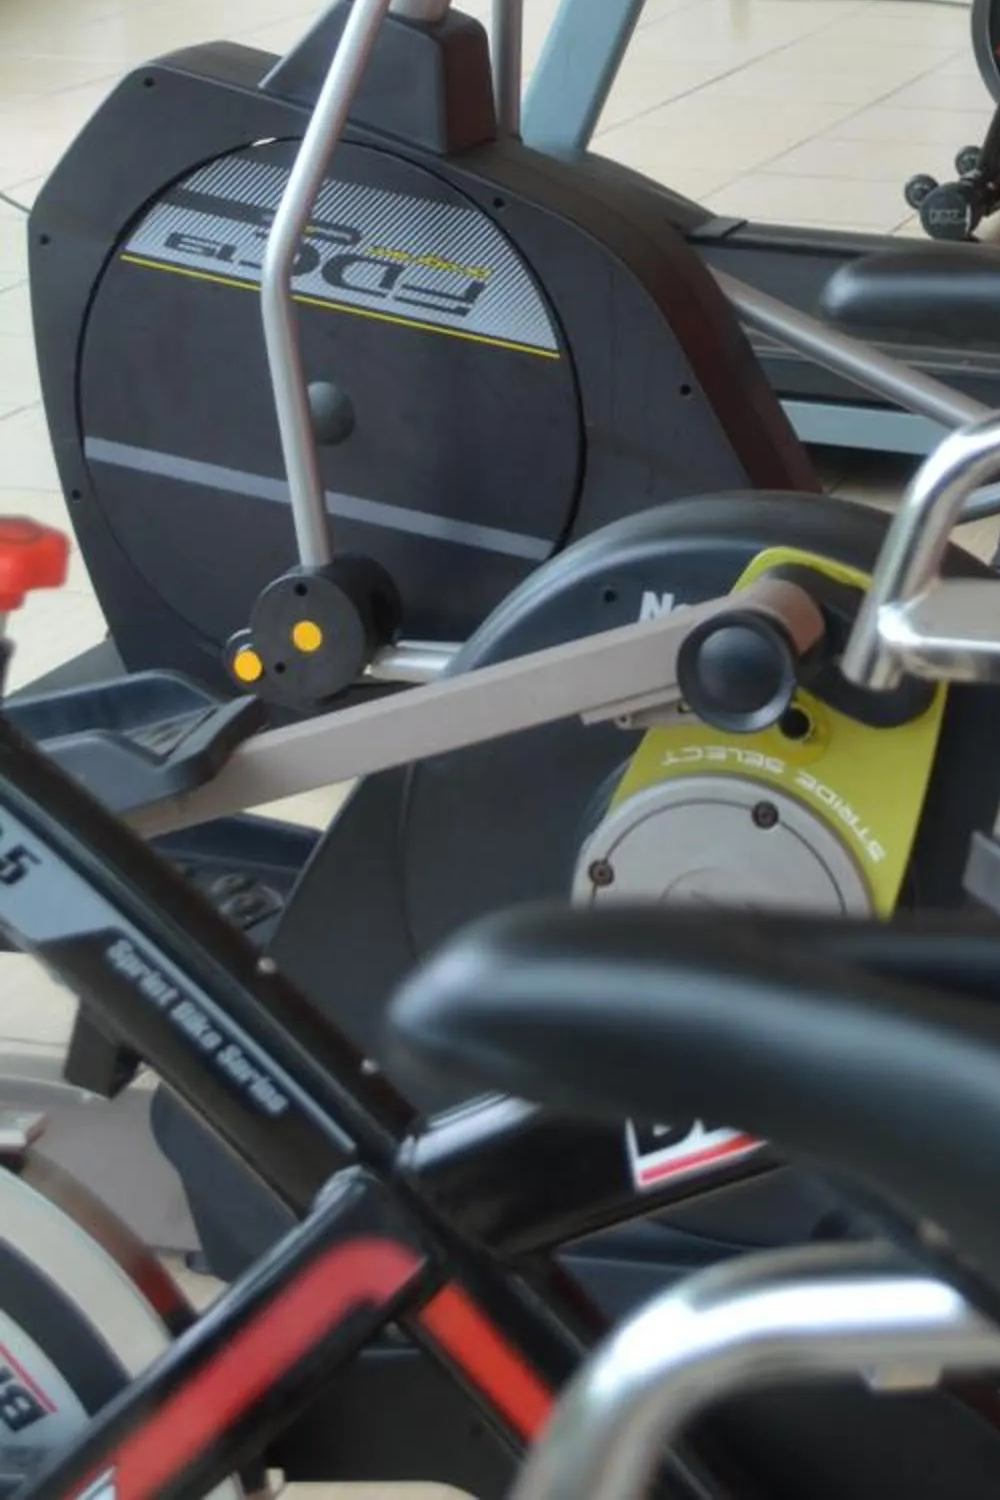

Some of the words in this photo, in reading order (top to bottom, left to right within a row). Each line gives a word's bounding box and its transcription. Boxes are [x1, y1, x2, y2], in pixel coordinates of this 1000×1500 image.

[661, 746, 785, 775] SELECT
[794, 770, 886, 862] STRIDE
[107, 938, 179, 1007] Sprint
[170, 1000, 223, 1050] Bike
[216, 1043, 290, 1115] Series
